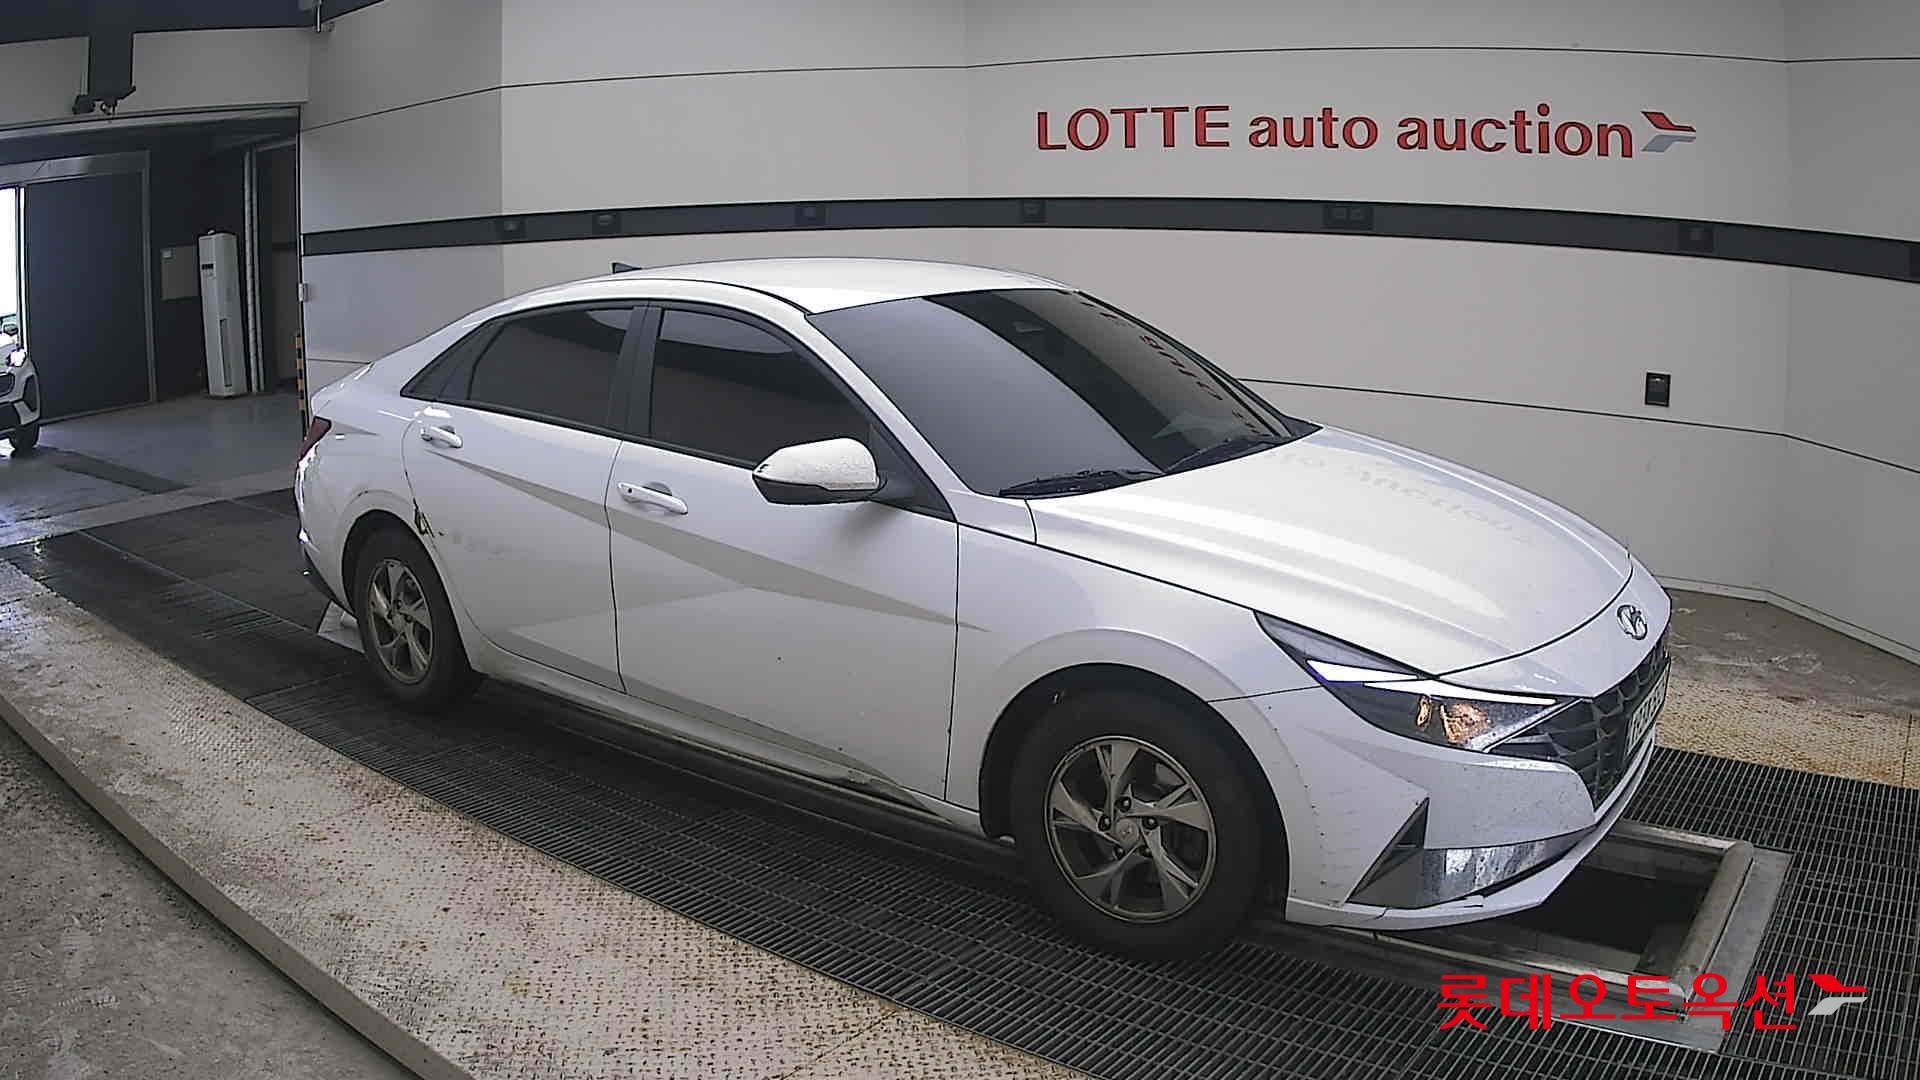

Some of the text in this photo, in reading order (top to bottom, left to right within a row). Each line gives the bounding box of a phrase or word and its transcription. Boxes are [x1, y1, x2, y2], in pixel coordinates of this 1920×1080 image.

[1036, 103, 1634, 159] LOTTE auto auction
